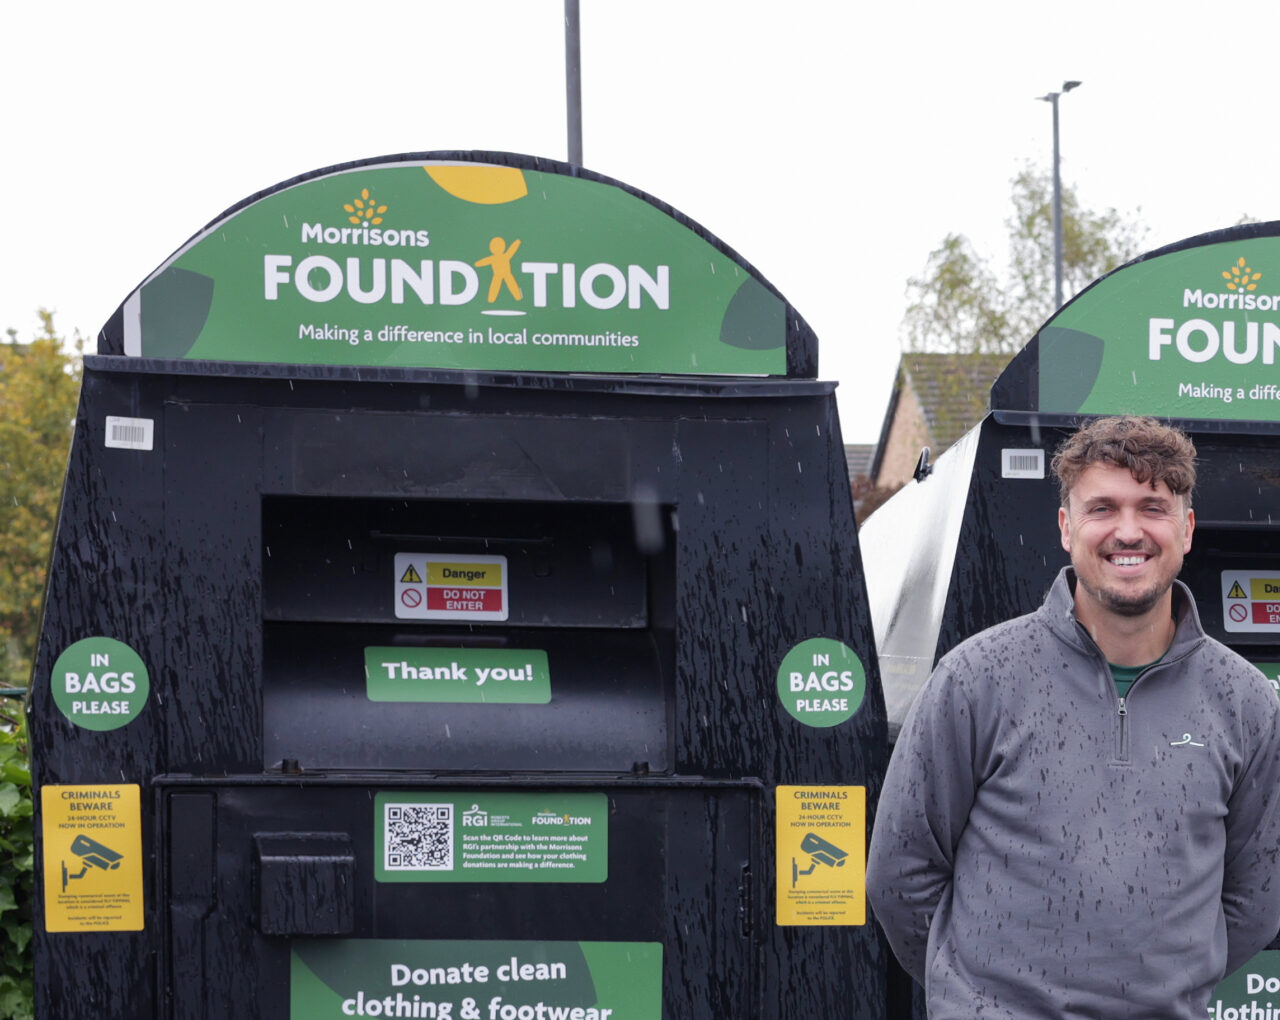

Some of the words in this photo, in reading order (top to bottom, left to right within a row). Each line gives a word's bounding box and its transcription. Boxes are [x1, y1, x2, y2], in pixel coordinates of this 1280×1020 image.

[302, 223, 429, 247] Morrisons
[299, 324, 359, 345] Making
[363, 330, 373, 341] a
[378, 325, 463, 343] difference
[469, 328, 483, 343] in
[489, 328, 527, 344] local
[532, 332, 639, 346] communities
[1179, 383, 1232, 402] Making
[1236, 389, 1246, 399] a
[442, 568, 487, 581] Danger
[443, 590, 459, 601] DO
[462, 590, 486, 601] NOT
[446, 601, 484, 612] ENTER
[1266, 604, 1280, 613] DO
[91, 654, 109, 668] IN
[812, 654, 830, 666] IN
[382, 662, 467, 680] Thank
[475, 664, 533, 686] you!
[66, 672, 136, 693] BAGS
[790, 671, 853, 691] BAGS
[72, 701, 130, 714] PLEASE
[796, 699, 849, 711] PLEASE
[60, 790, 121, 800] CRIMINALS
[793, 791, 848, 800] CRIMINALS
[69, 801, 113, 811] BEWARE
[801, 801, 840, 811] BEWARE
[463, 815, 488, 827] RGI
[492, 834, 504, 842] QR
[504, 834, 523, 842] Code
[531, 834, 550, 842] learn
[568, 834, 589, 842] about
[391, 963, 489, 986] Donate
[497, 957, 566, 981] clean
[460, 998, 480, 1019] &
